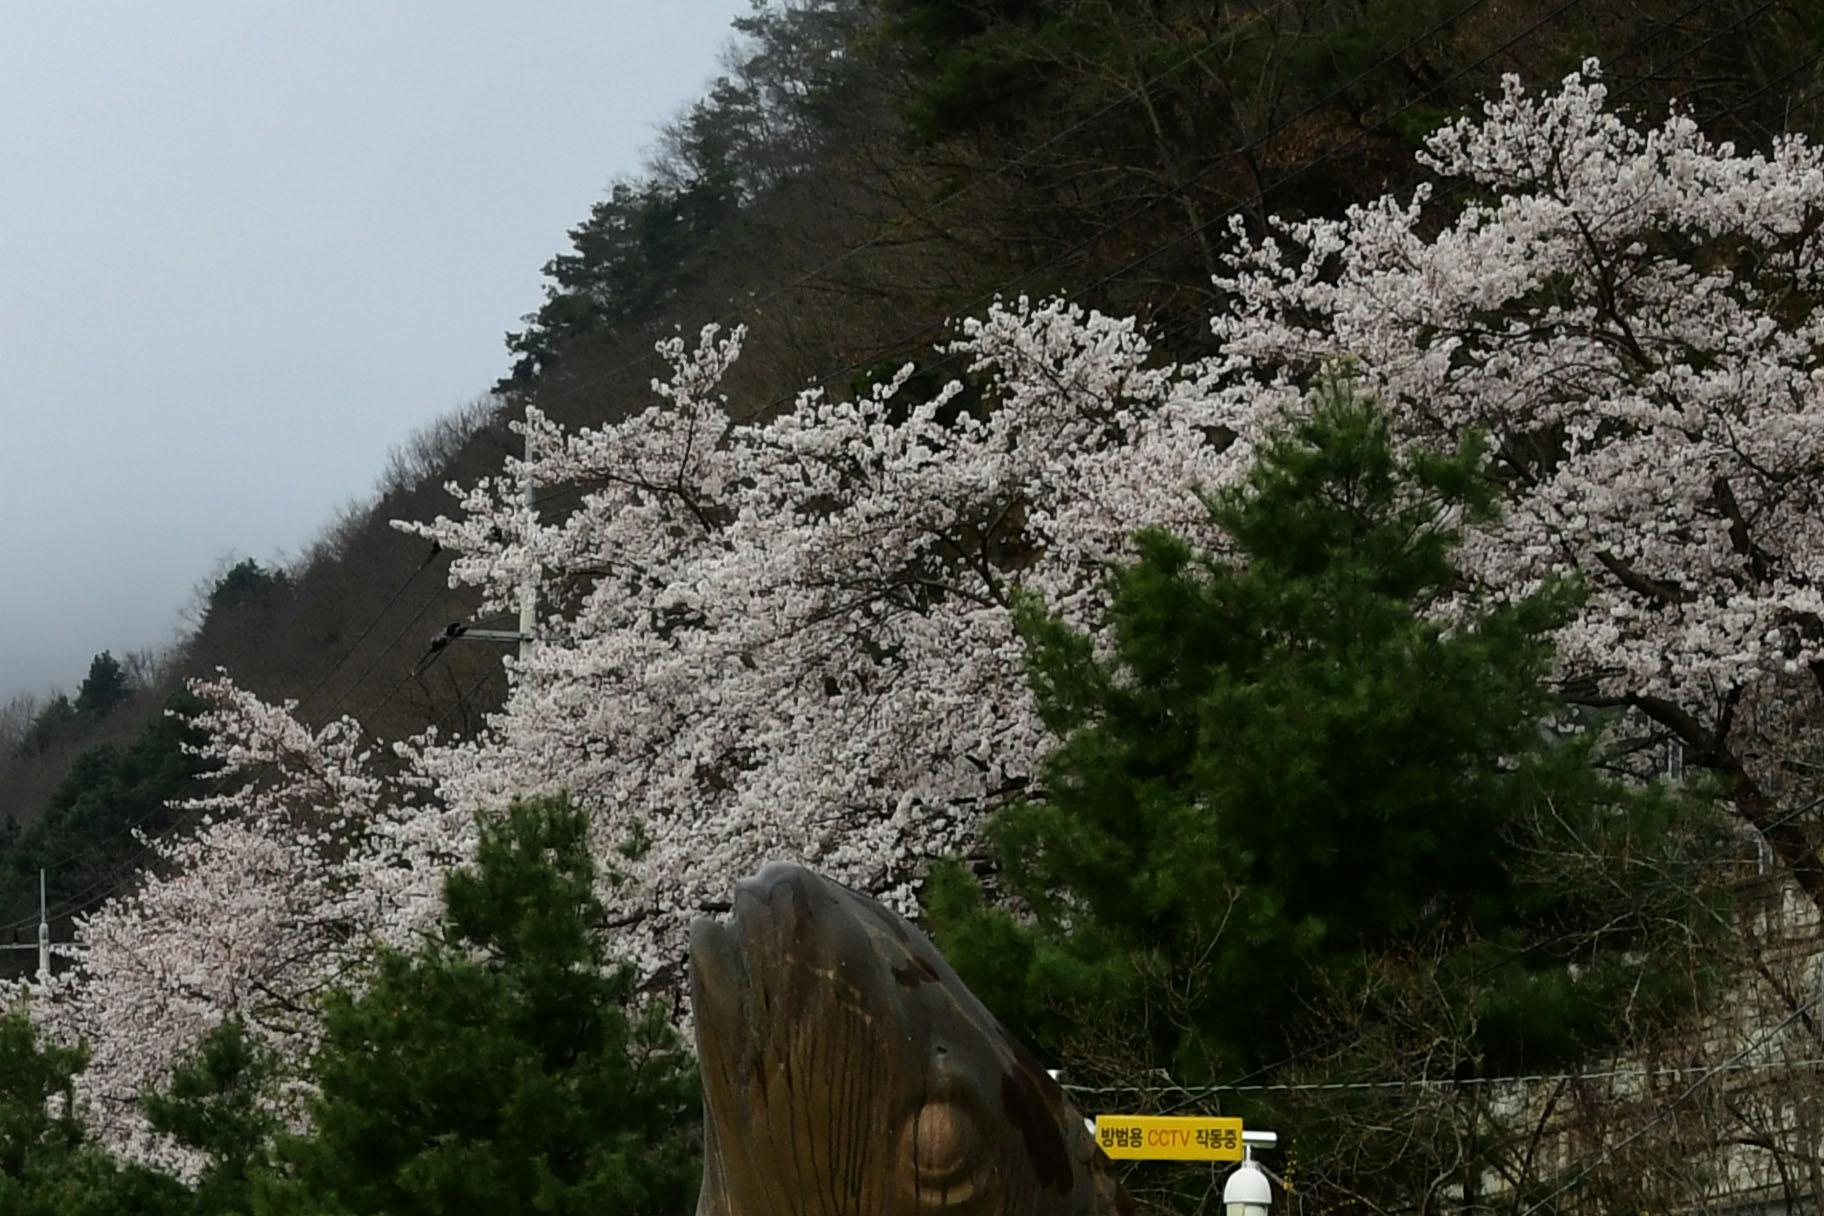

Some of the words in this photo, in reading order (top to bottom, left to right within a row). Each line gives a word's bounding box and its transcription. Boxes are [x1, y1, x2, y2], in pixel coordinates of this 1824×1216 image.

[1101, 1127, 1144, 1148] 방범용
[1148, 1130, 1191, 1147] CCTV
[1195, 1128, 1237, 1149] 작동중
